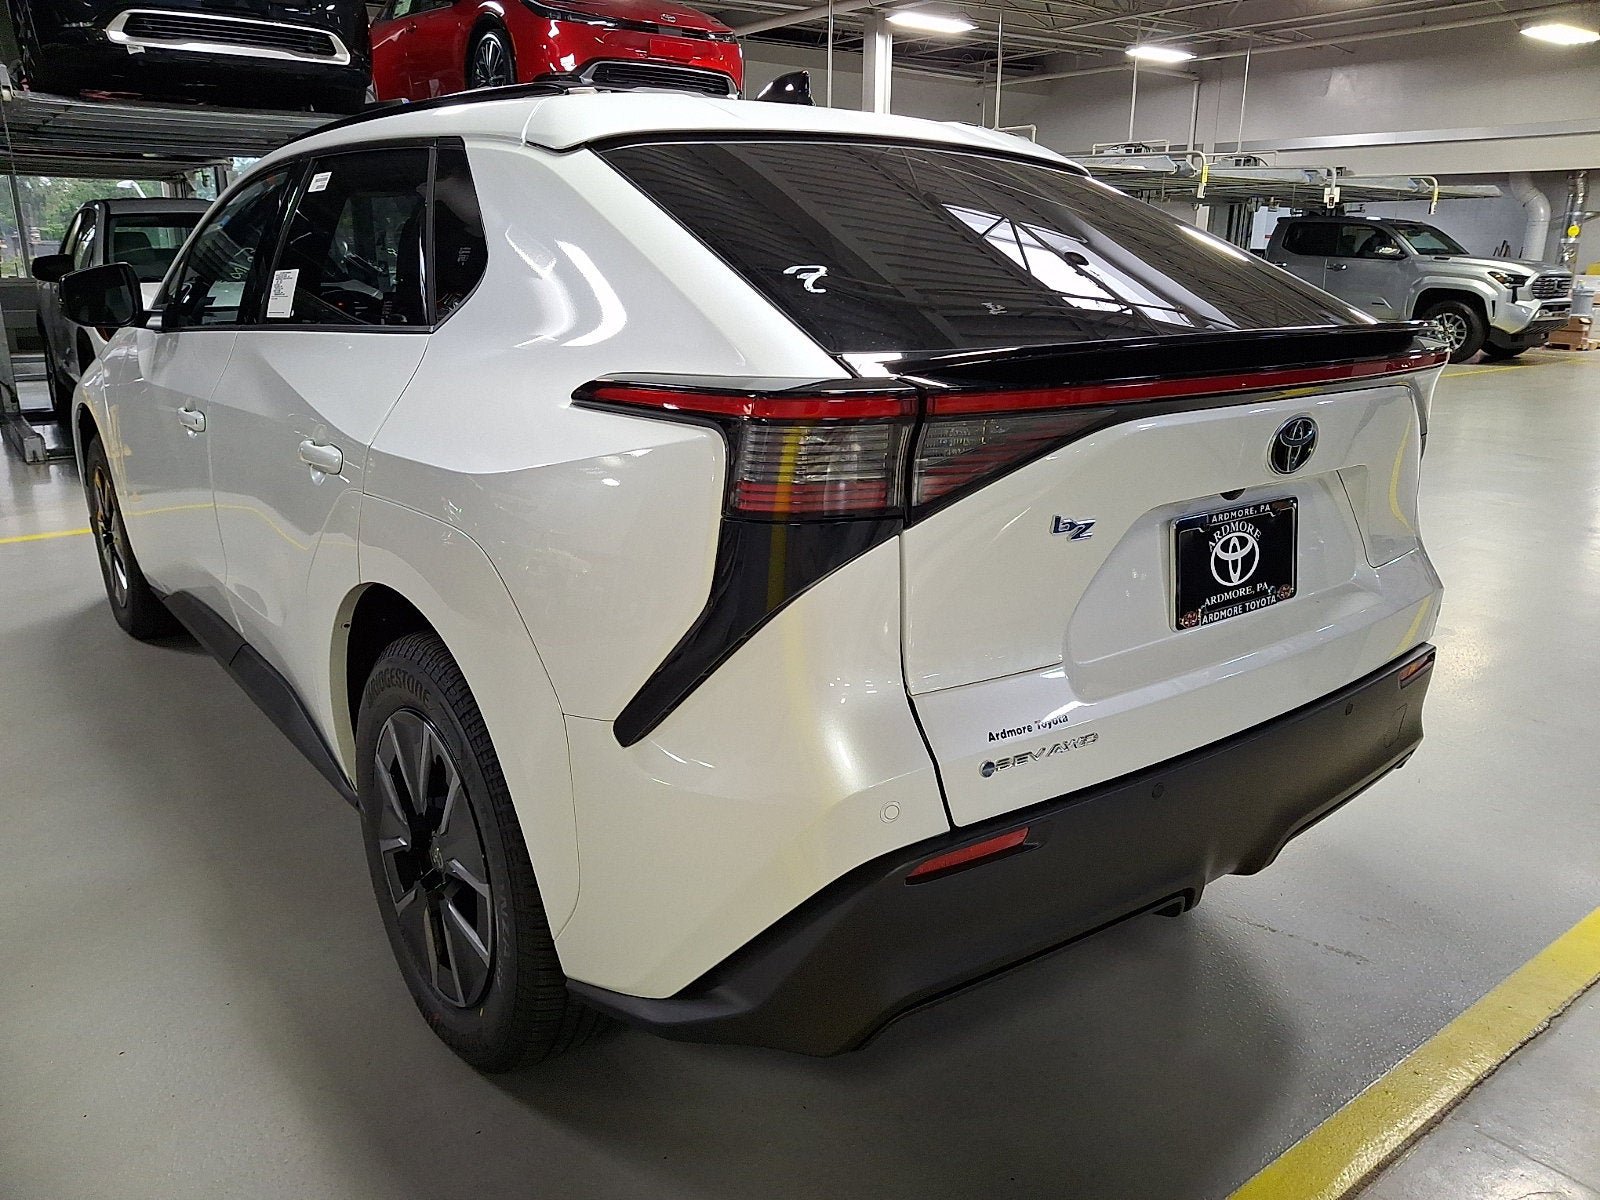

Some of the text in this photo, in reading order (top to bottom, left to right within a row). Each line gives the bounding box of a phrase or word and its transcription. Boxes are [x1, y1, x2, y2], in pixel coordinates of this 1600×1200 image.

[1211, 502, 1271, 524] ARDMORE, PA
[1208, 520, 1262, 553] ARDMORE
[1203, 581, 1269, 608] ARDMORE, PA
[1201, 595, 1277, 625] ARDMORE TOYOTA
[988, 714, 1069, 742] Ardmore Toyota
[995, 747, 1046, 772] BEV
